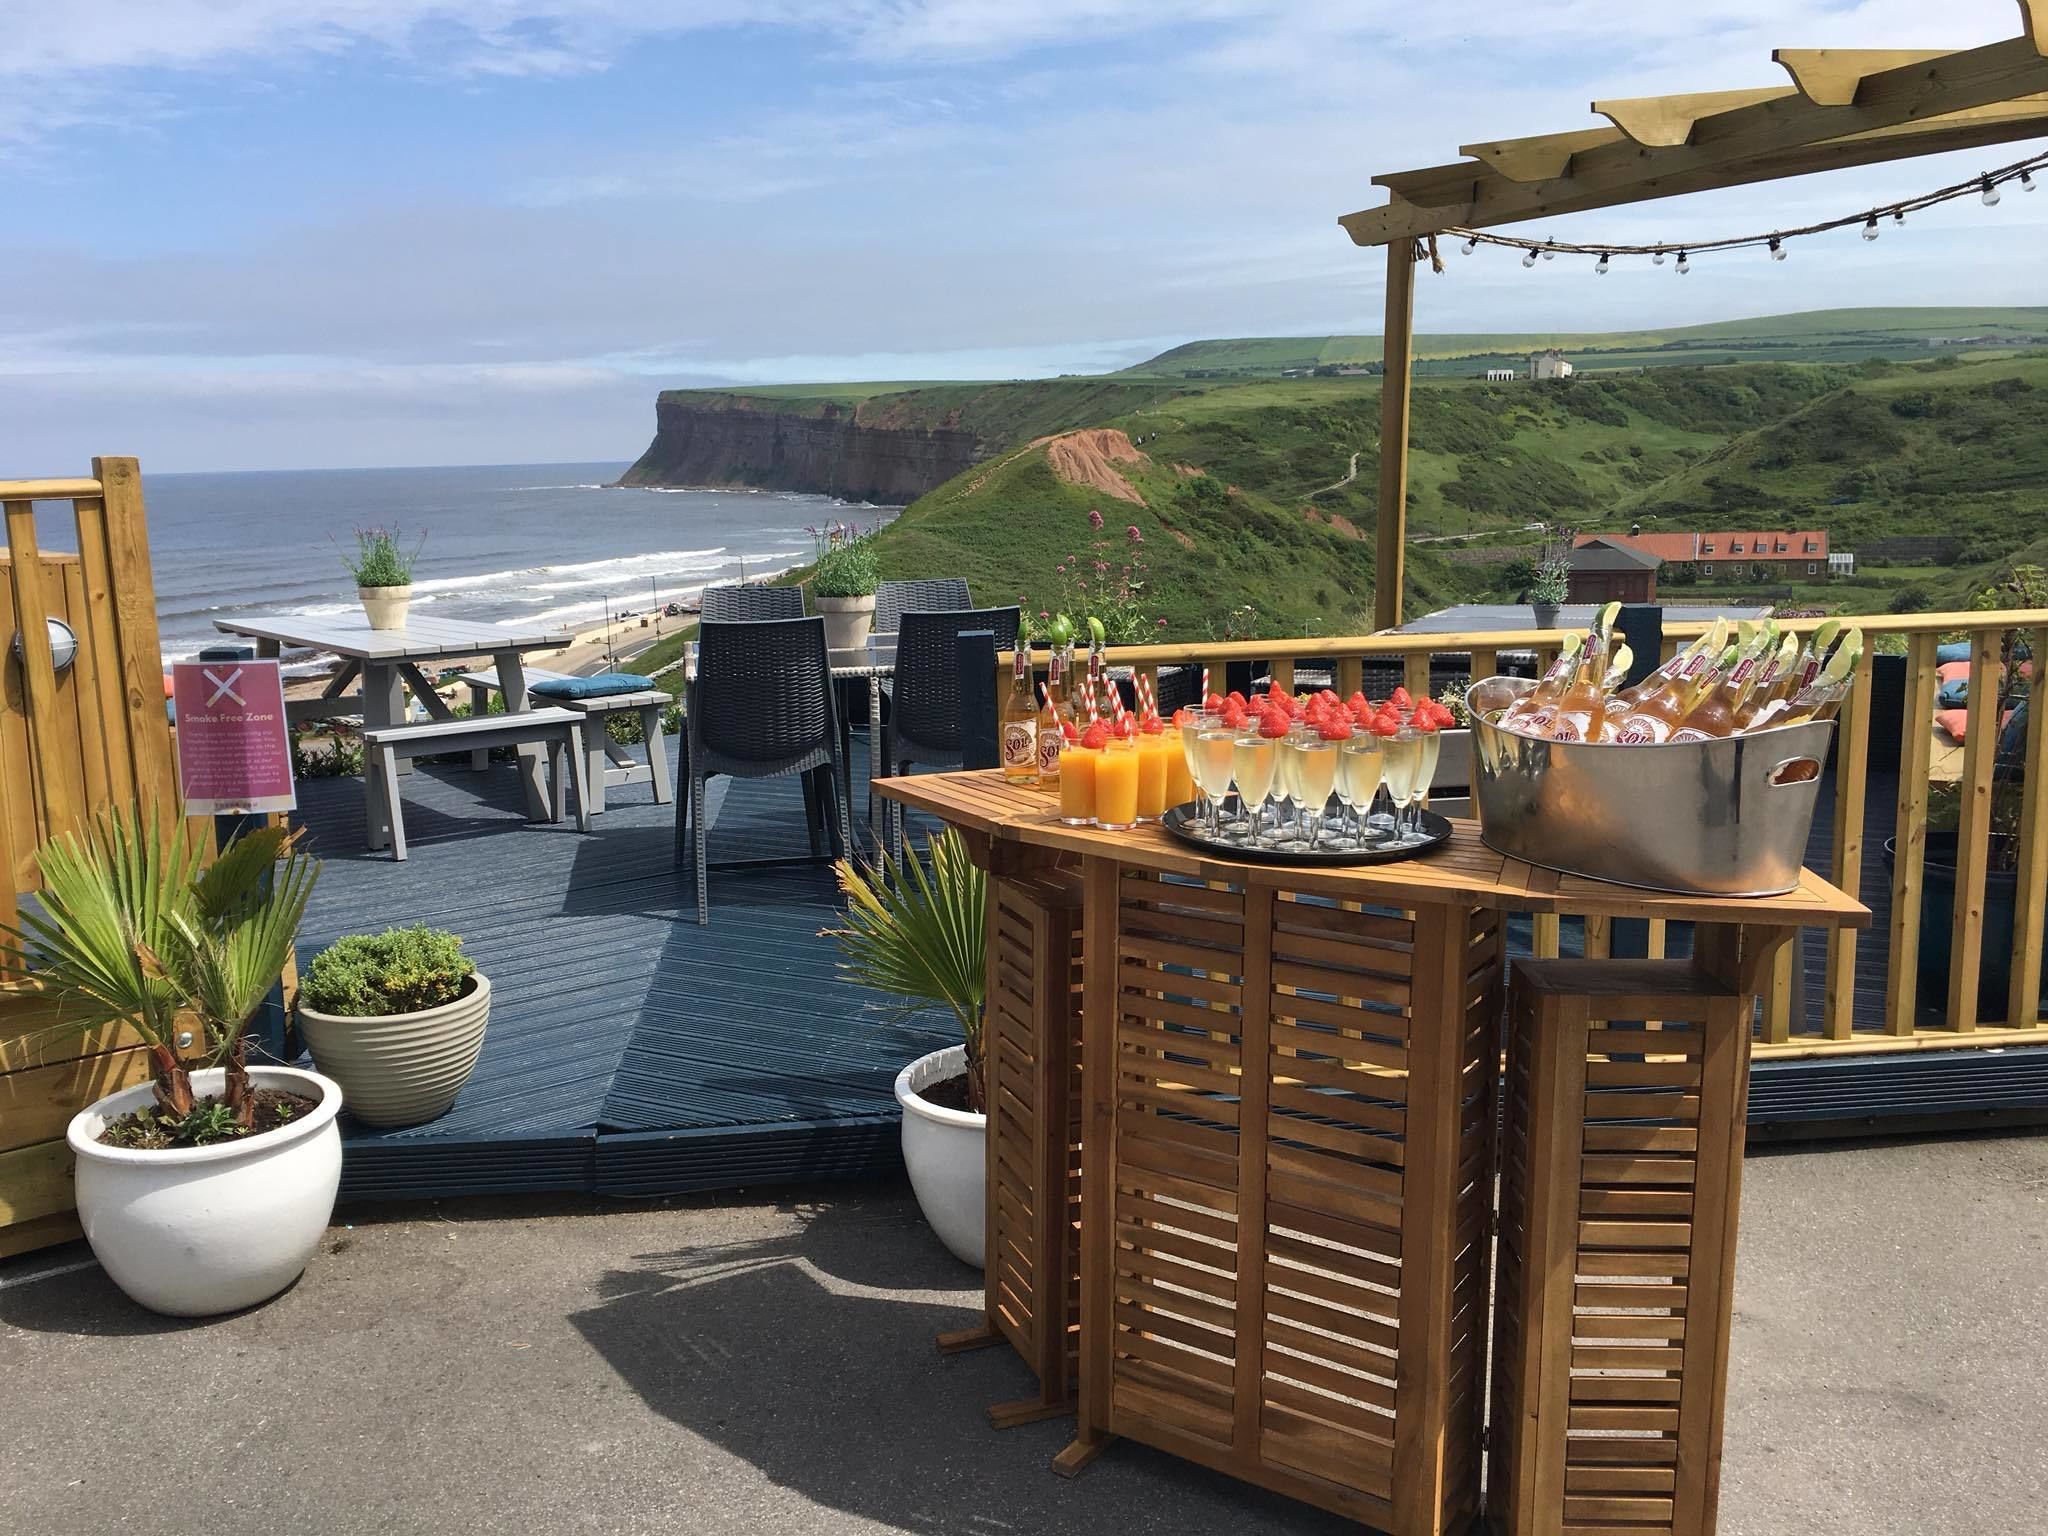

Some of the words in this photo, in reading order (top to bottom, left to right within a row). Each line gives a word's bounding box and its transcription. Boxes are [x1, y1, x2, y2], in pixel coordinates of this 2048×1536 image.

[185, 714, 217, 722] Smoke
[220, 714, 243, 722] Free
[246, 712, 273, 720] Zone
[1006, 737, 1028, 760] SOL
